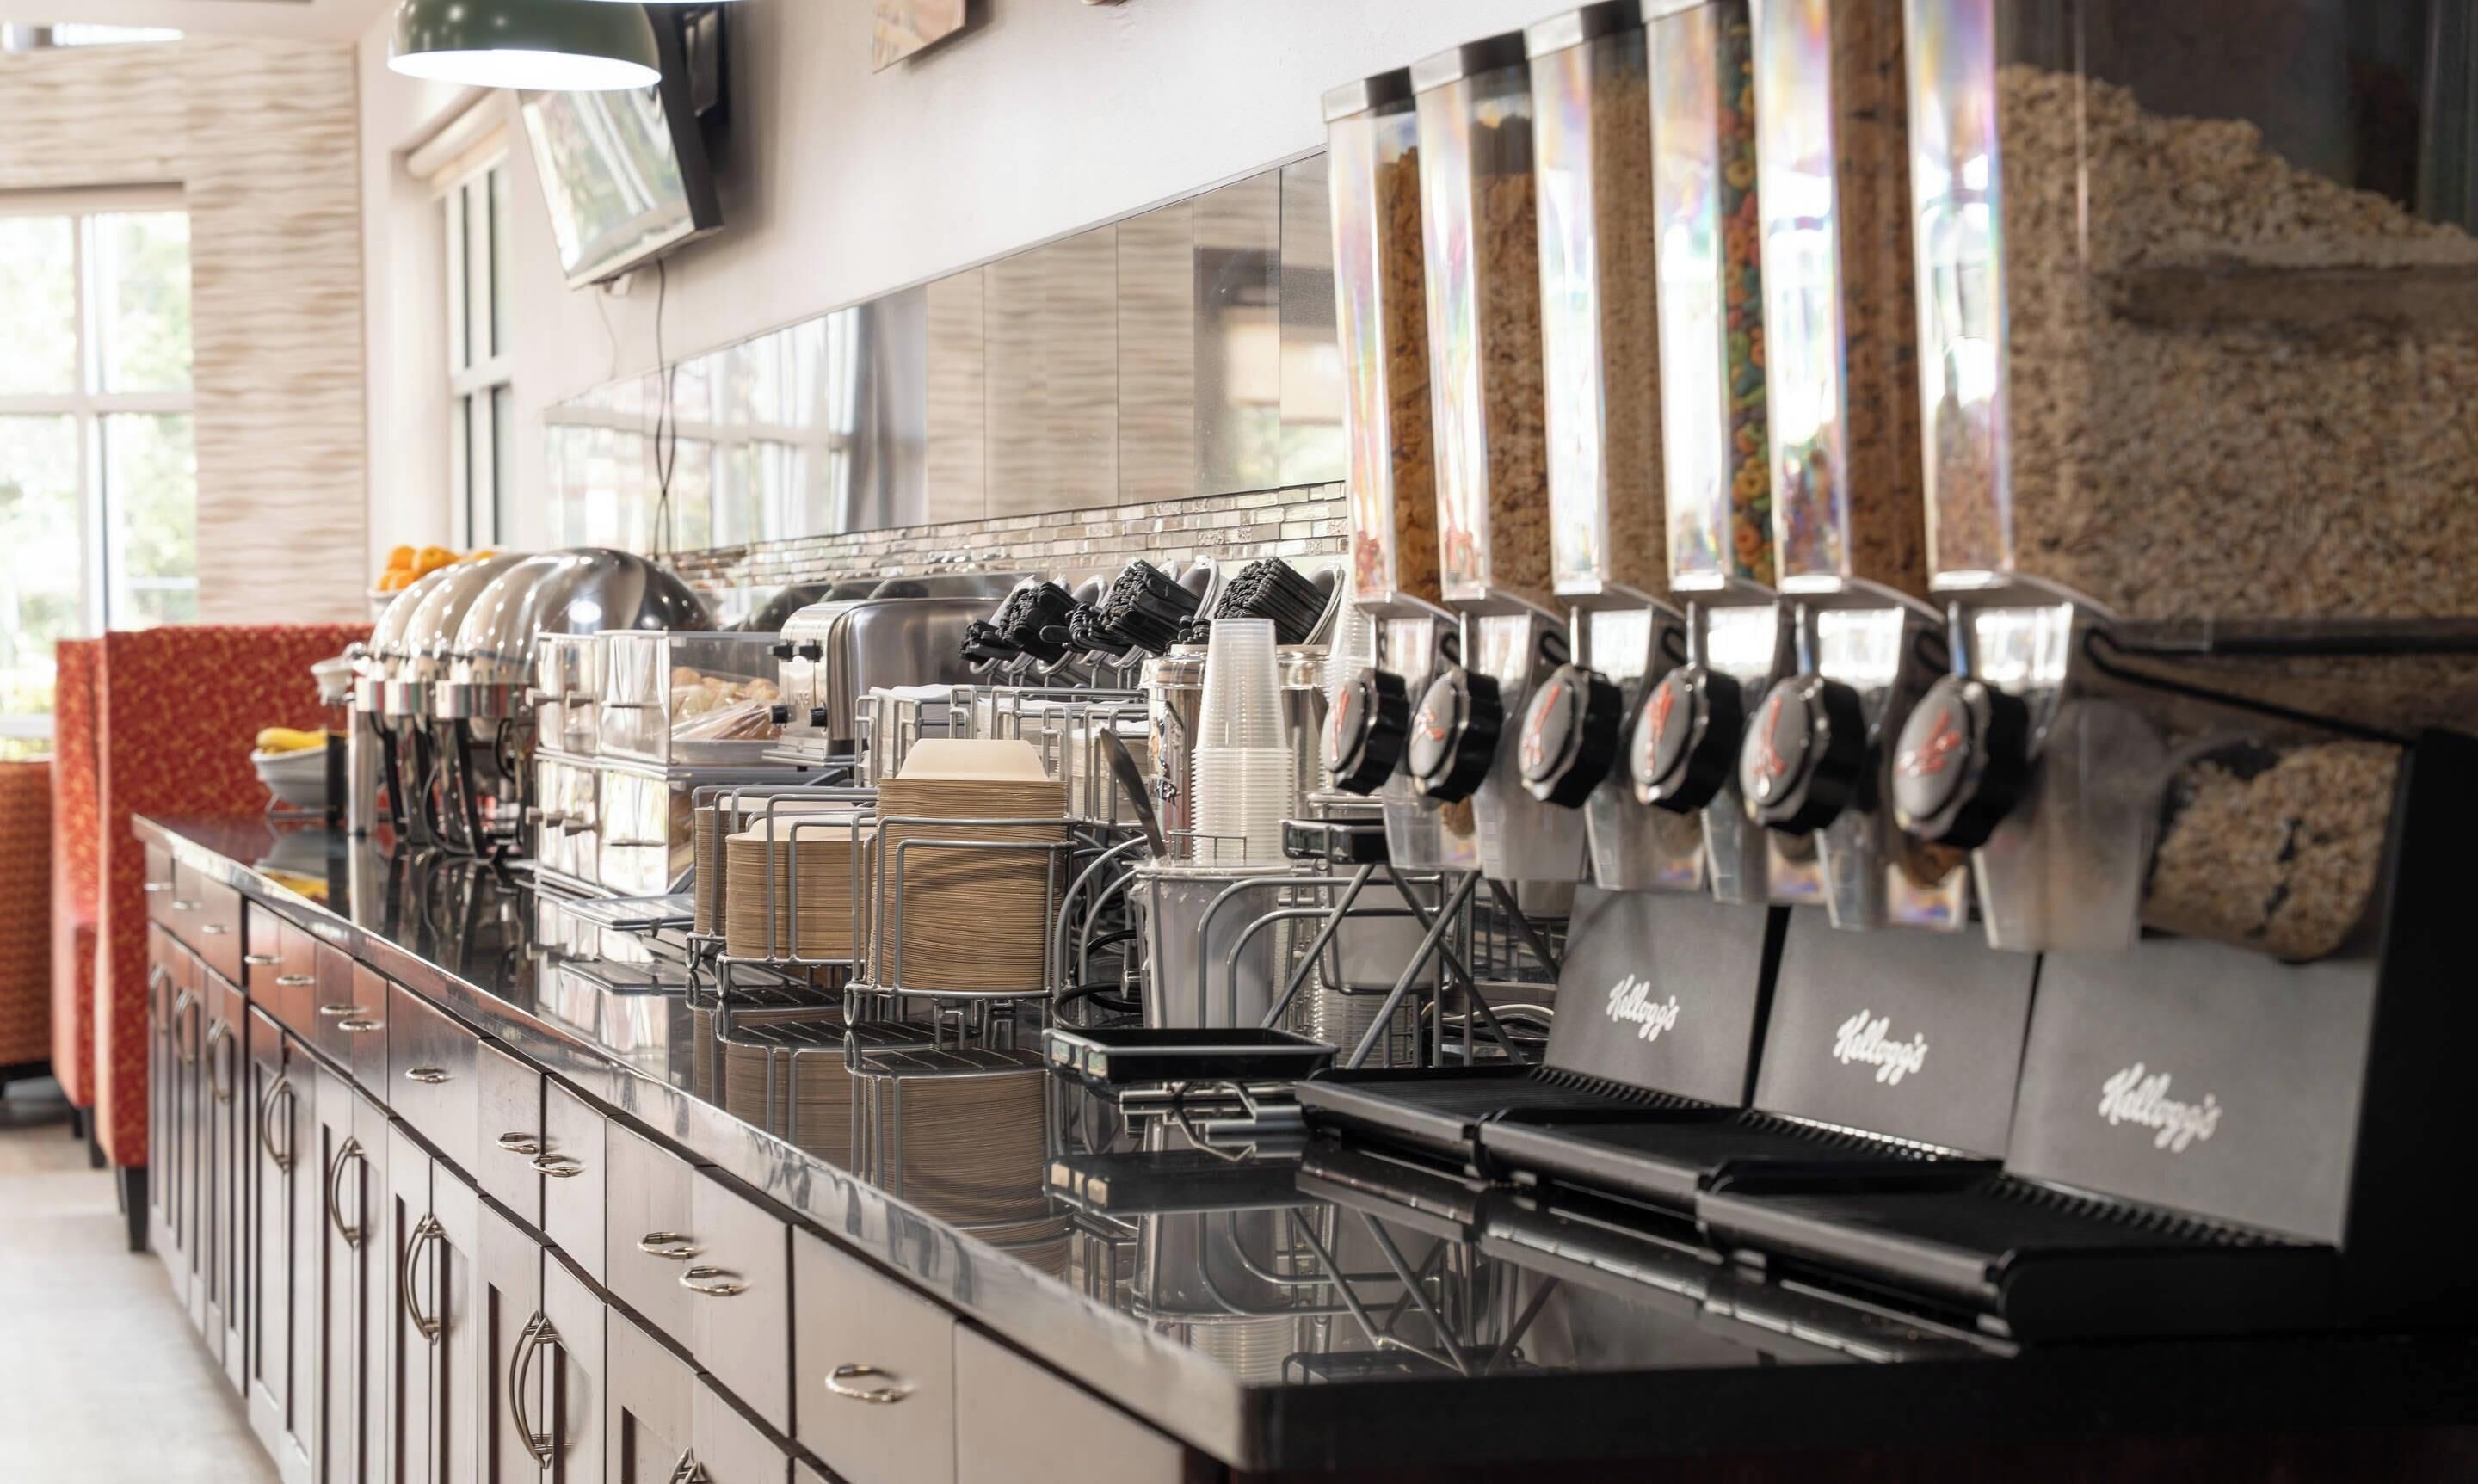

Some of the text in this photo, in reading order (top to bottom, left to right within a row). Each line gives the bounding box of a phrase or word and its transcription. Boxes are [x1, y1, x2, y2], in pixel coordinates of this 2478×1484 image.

[1606, 973, 1680, 1042] Kellogg's
[1832, 1008, 1928, 1086] Kellogg's
[2098, 1062, 2222, 1154] Kellogg's
